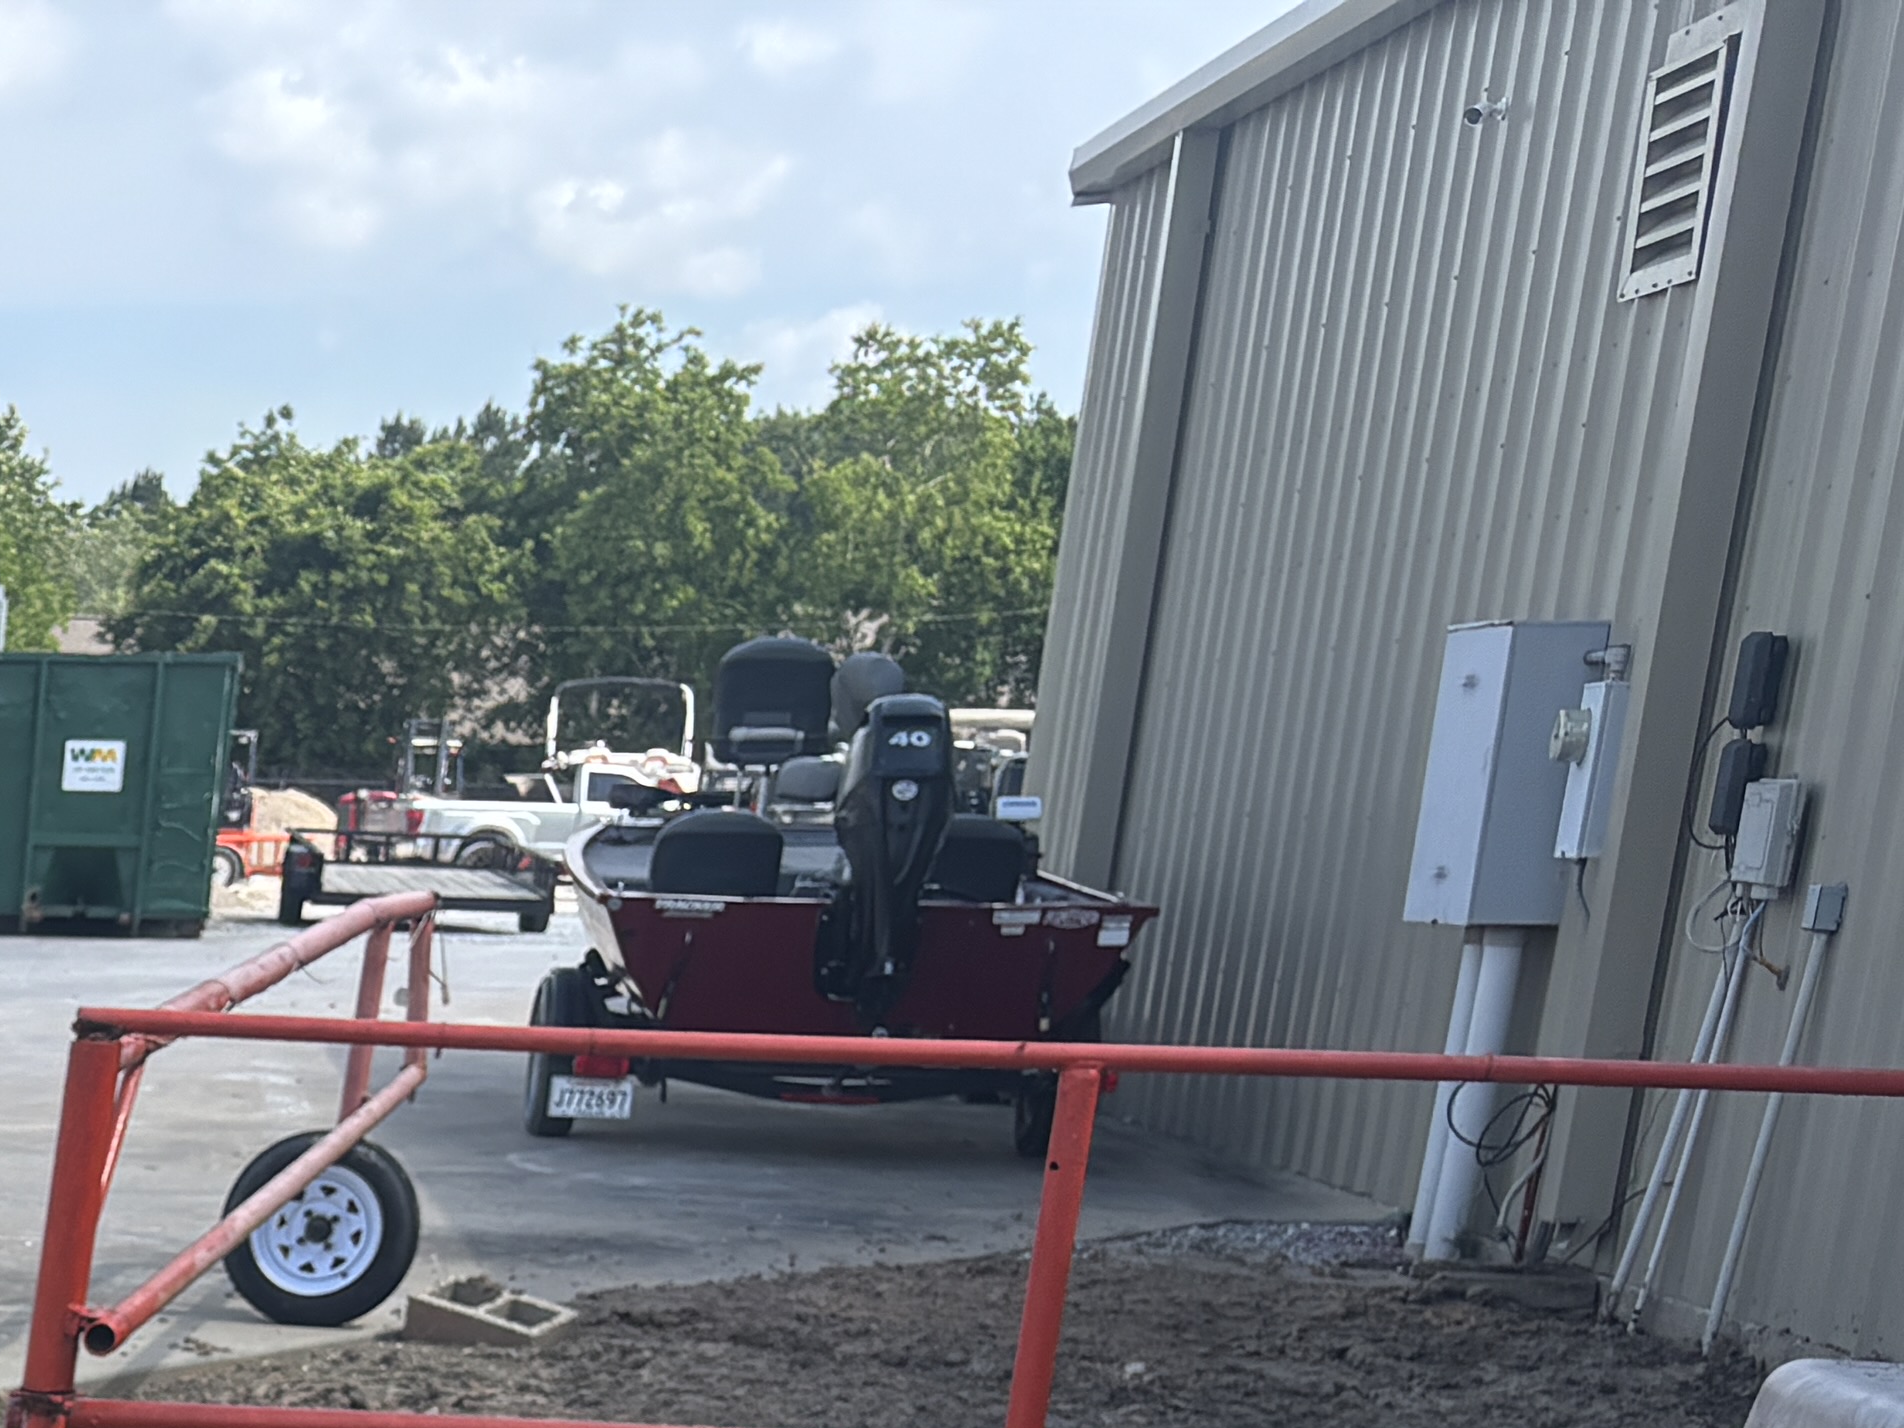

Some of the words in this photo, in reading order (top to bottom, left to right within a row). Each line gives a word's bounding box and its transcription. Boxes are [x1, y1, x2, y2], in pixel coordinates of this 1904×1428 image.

[888, 730, 932, 747] 40
[71, 747, 118, 763] WM
[554, 1088, 628, 1110] J772697
